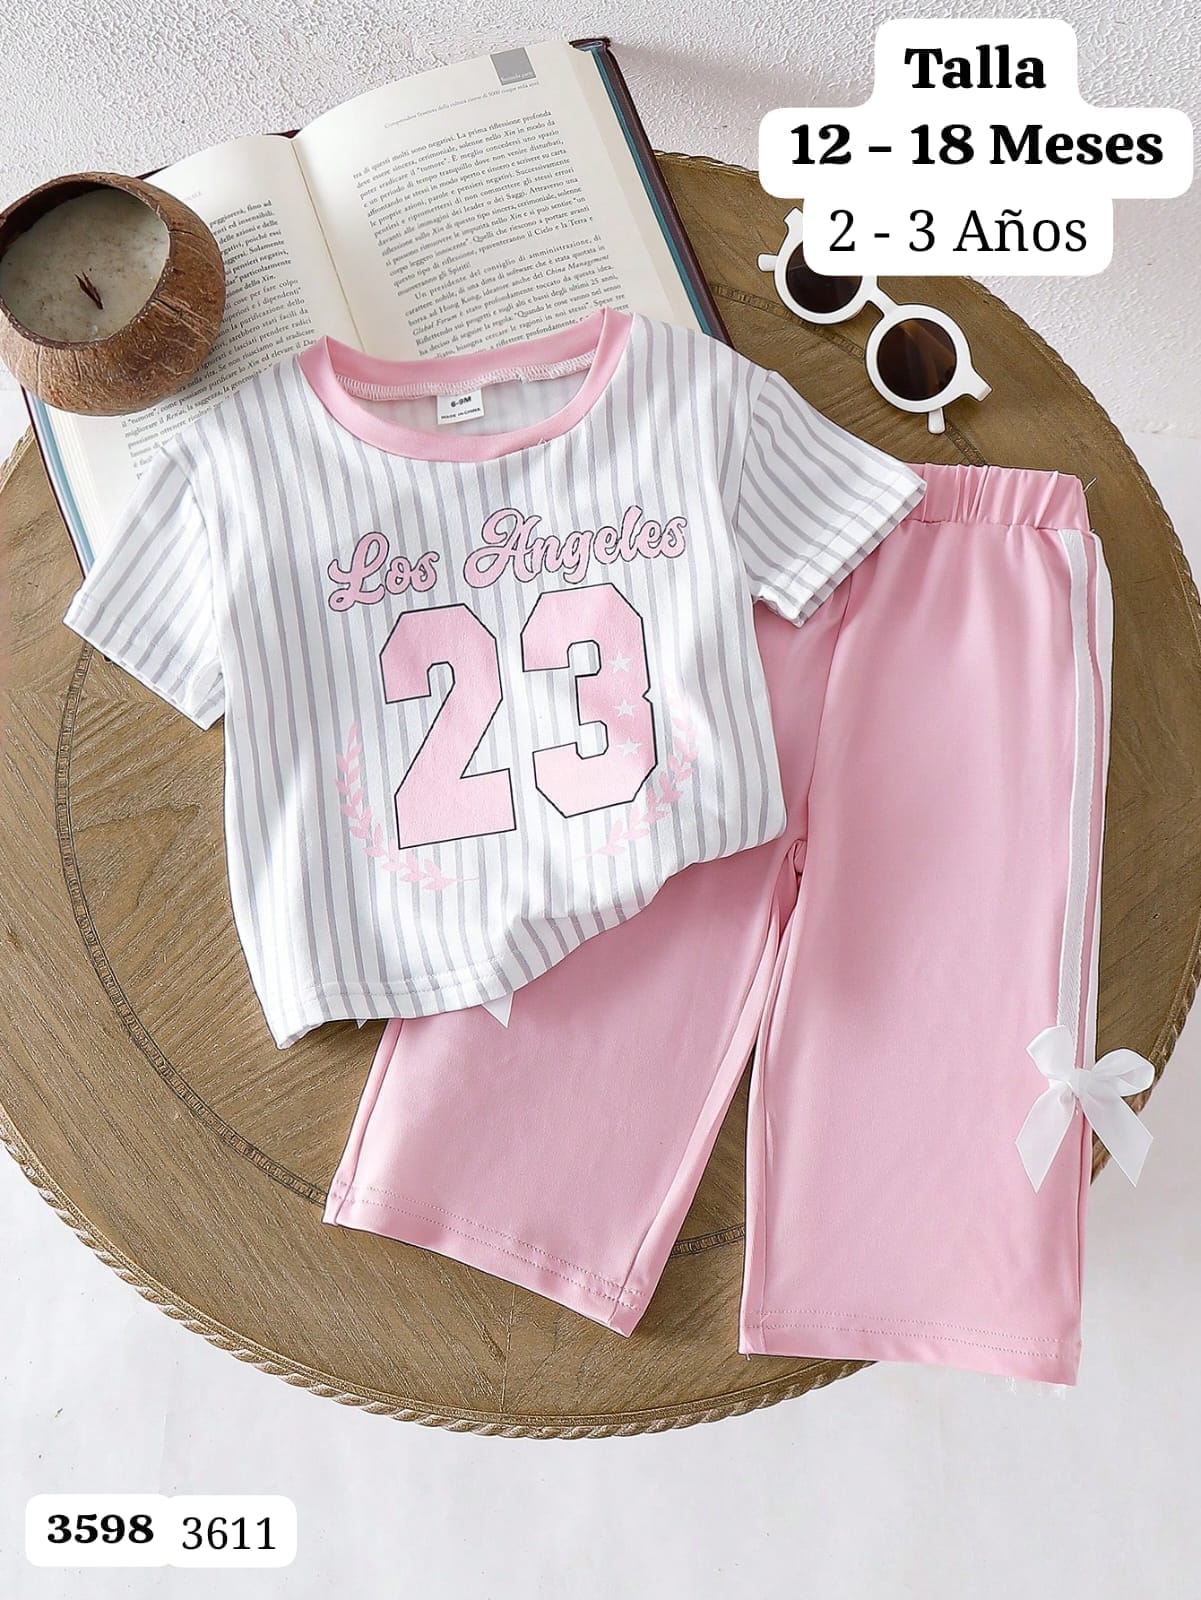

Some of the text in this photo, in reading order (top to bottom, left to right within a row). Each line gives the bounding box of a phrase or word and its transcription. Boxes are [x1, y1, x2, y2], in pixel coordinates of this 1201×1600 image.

[458, 136, 483, 149] solenne
[484, 132, 501, 142] nello
[501, 129, 515, 137] Xin
[525, 121, 545, 131] modo
[467, 127, 487, 138] prima
[487, 118, 521, 130] riflessione
[521, 109, 551, 124] profonda
[459, 148, 483, 160] meglio
[537, 129, 559, 140] spazio
[366, 196, 403, 217] affrontando
[411, 186, 430, 197] stessi
[438, 176, 458, 188] modo
[459, 171, 480, 182] aperto
[515, 154, 540, 165] scrivere
[549, 148, 566, 156] carta
[377, 209, 402, 225] proprie
[427, 191, 448, 204] parole
[456, 179, 483, 195] pensieri
[514, 158, 570, 176] Successivamente
[379, 184, 405, 202] periodo
[473, 158, 490, 166] dove
[246, 203, 262, 211] fino
[373, 220, 399, 239] pentirsi
[407, 199, 453, 221] ripromettersi
[479, 181, 520, 196] commettere
[521, 177, 532, 186] gli
[533, 171, 552, 181] stessi
[552, 166, 574, 176] errori
[377, 230, 402, 247] davanti
[450, 207, 462, 216] dei
[462, 201, 484, 212] leader
[492, 194, 504, 203] dei
[527, 181, 563, 194] Attraverso
[431, 226, 444, 235] Xin
[476, 211, 490, 220] tipo
[556, 186, 582, 197] solenne
[218, 219, 278, 244] delle azioni delle
[391, 199, 572, 265] possono nello Xin può sentire
[494, 227, 507, 236] che
[543, 211, 568, 224] portare
[569, 204, 589, 215] avanti
[244, 229, 281, 247] poiché essi
[248, 239, 284, 254] Solamente
[478, 217, 587, 253] spaventeranno Cielo Terra
[232, 256, 258, 274] pensieri
[238, 259, 291, 283] particolarmente
[468, 268, 481, 278] del
[534, 260, 547, 268] che
[554, 254, 570, 262] stata
[232, 284, 276, 306] cose per fare
[438, 301, 460, 313] Hong
[532, 271, 545, 279] del
[545, 266, 566, 276] China
[567, 254, 609, 271] Management
[531, 291, 549, 302] bassi
[549, 286, 567, 296] degli
[535, 279, 560, 290] toccato
[590, 287, 602, 296] nel
[239, 297, 304, 328] purificazione dello
[592, 297, 613, 307] Spese
[228, 324, 260, 343] sarebbero
[261, 316, 277, 327] stati
[233, 336, 259, 352] lasciati
[258, 324, 289, 342] prendere
[242, 342, 273, 359] riusciamo
[159, 400, 178, 412] come
[176, 385, 207, 405] possiamo
[208, 370, 237, 390] purificare
[246, 359, 259, 369] Xin
[270, 345, 294, 358] elevare
[327, 505, 688, 612] Los Angeles
[379, 582, 658, 850] 23
